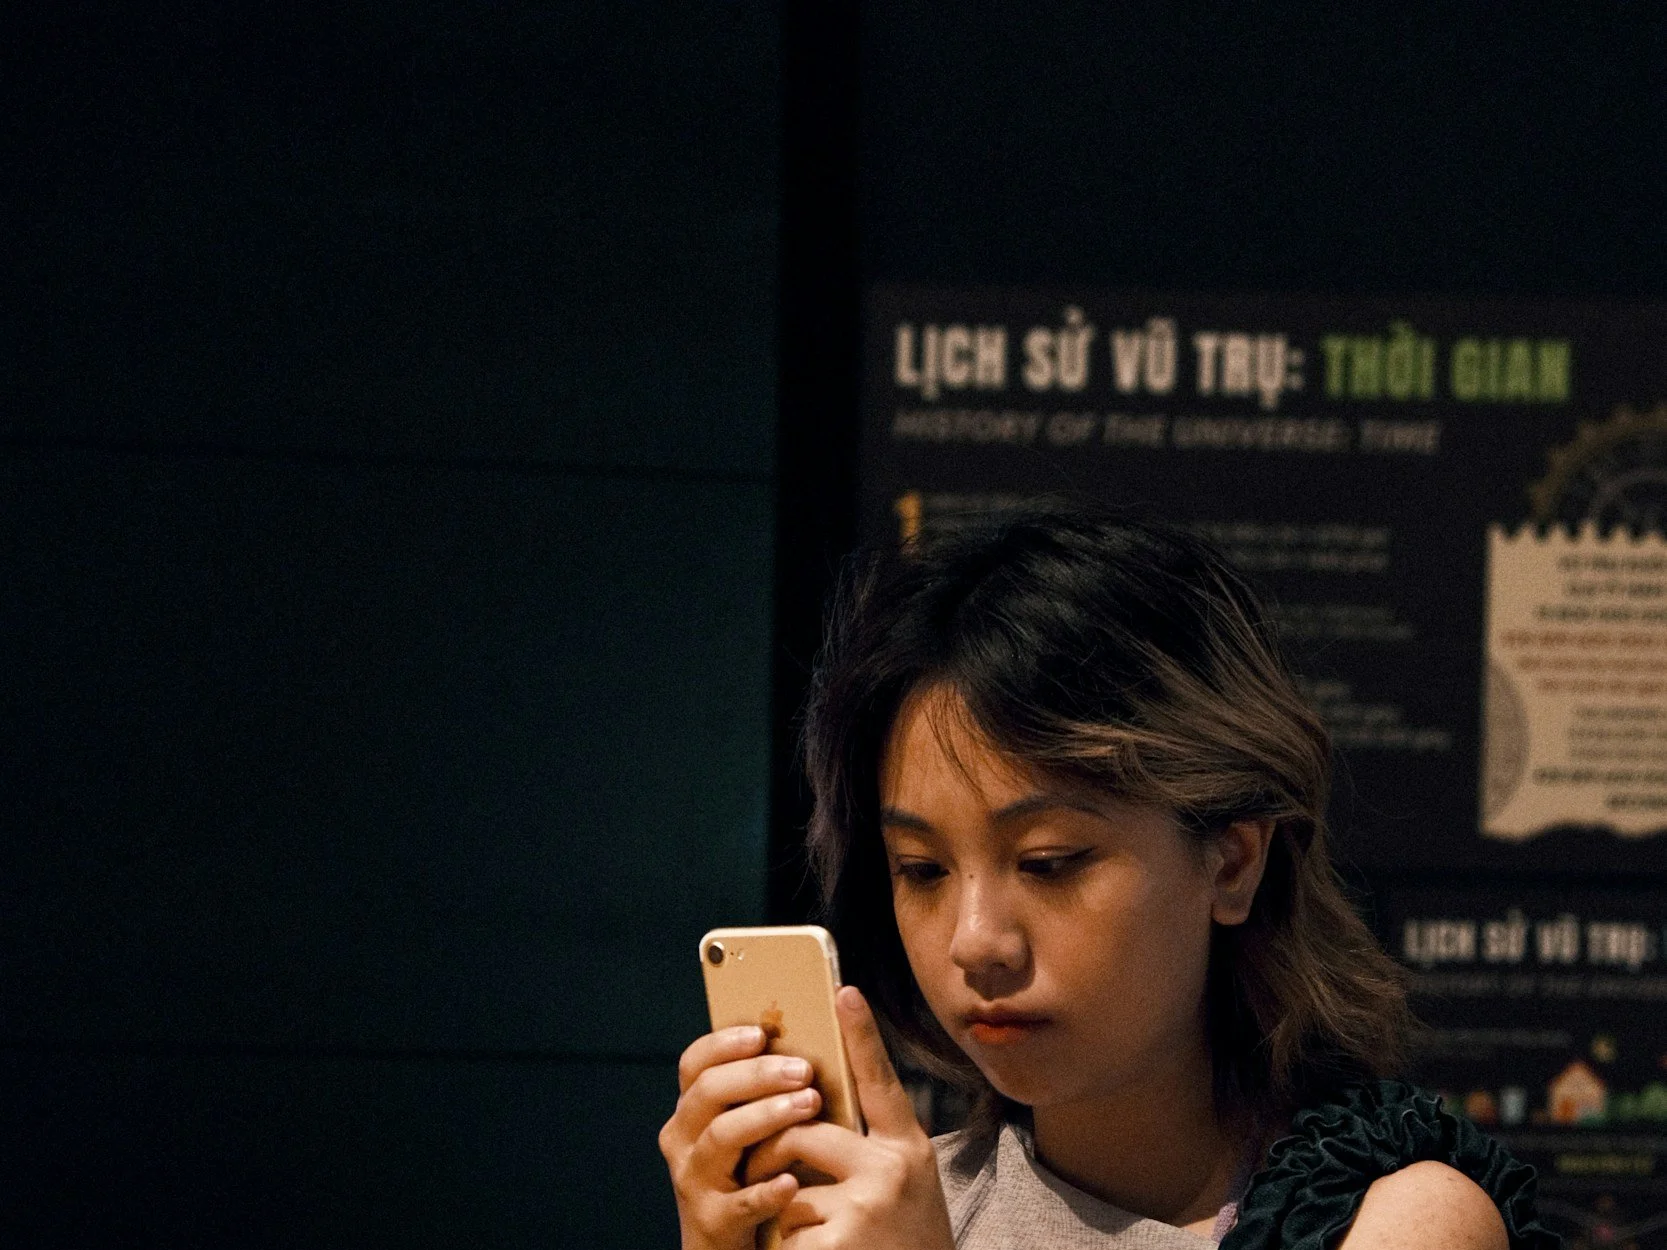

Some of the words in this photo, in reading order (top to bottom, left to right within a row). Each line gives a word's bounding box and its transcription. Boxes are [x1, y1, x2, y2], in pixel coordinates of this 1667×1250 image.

[895, 321, 1008, 399] LỊCH
[1022, 306, 1095, 392] SỬ
[1109, 316, 1178, 393] VŨ
[1192, 330, 1305, 411] TRỤ:
[1451, 336, 1573, 402] GIAN
[892, 411, 1041, 443] HISTORY
[1044, 413, 1097, 445] OF
[1101, 414, 1168, 448] THE
